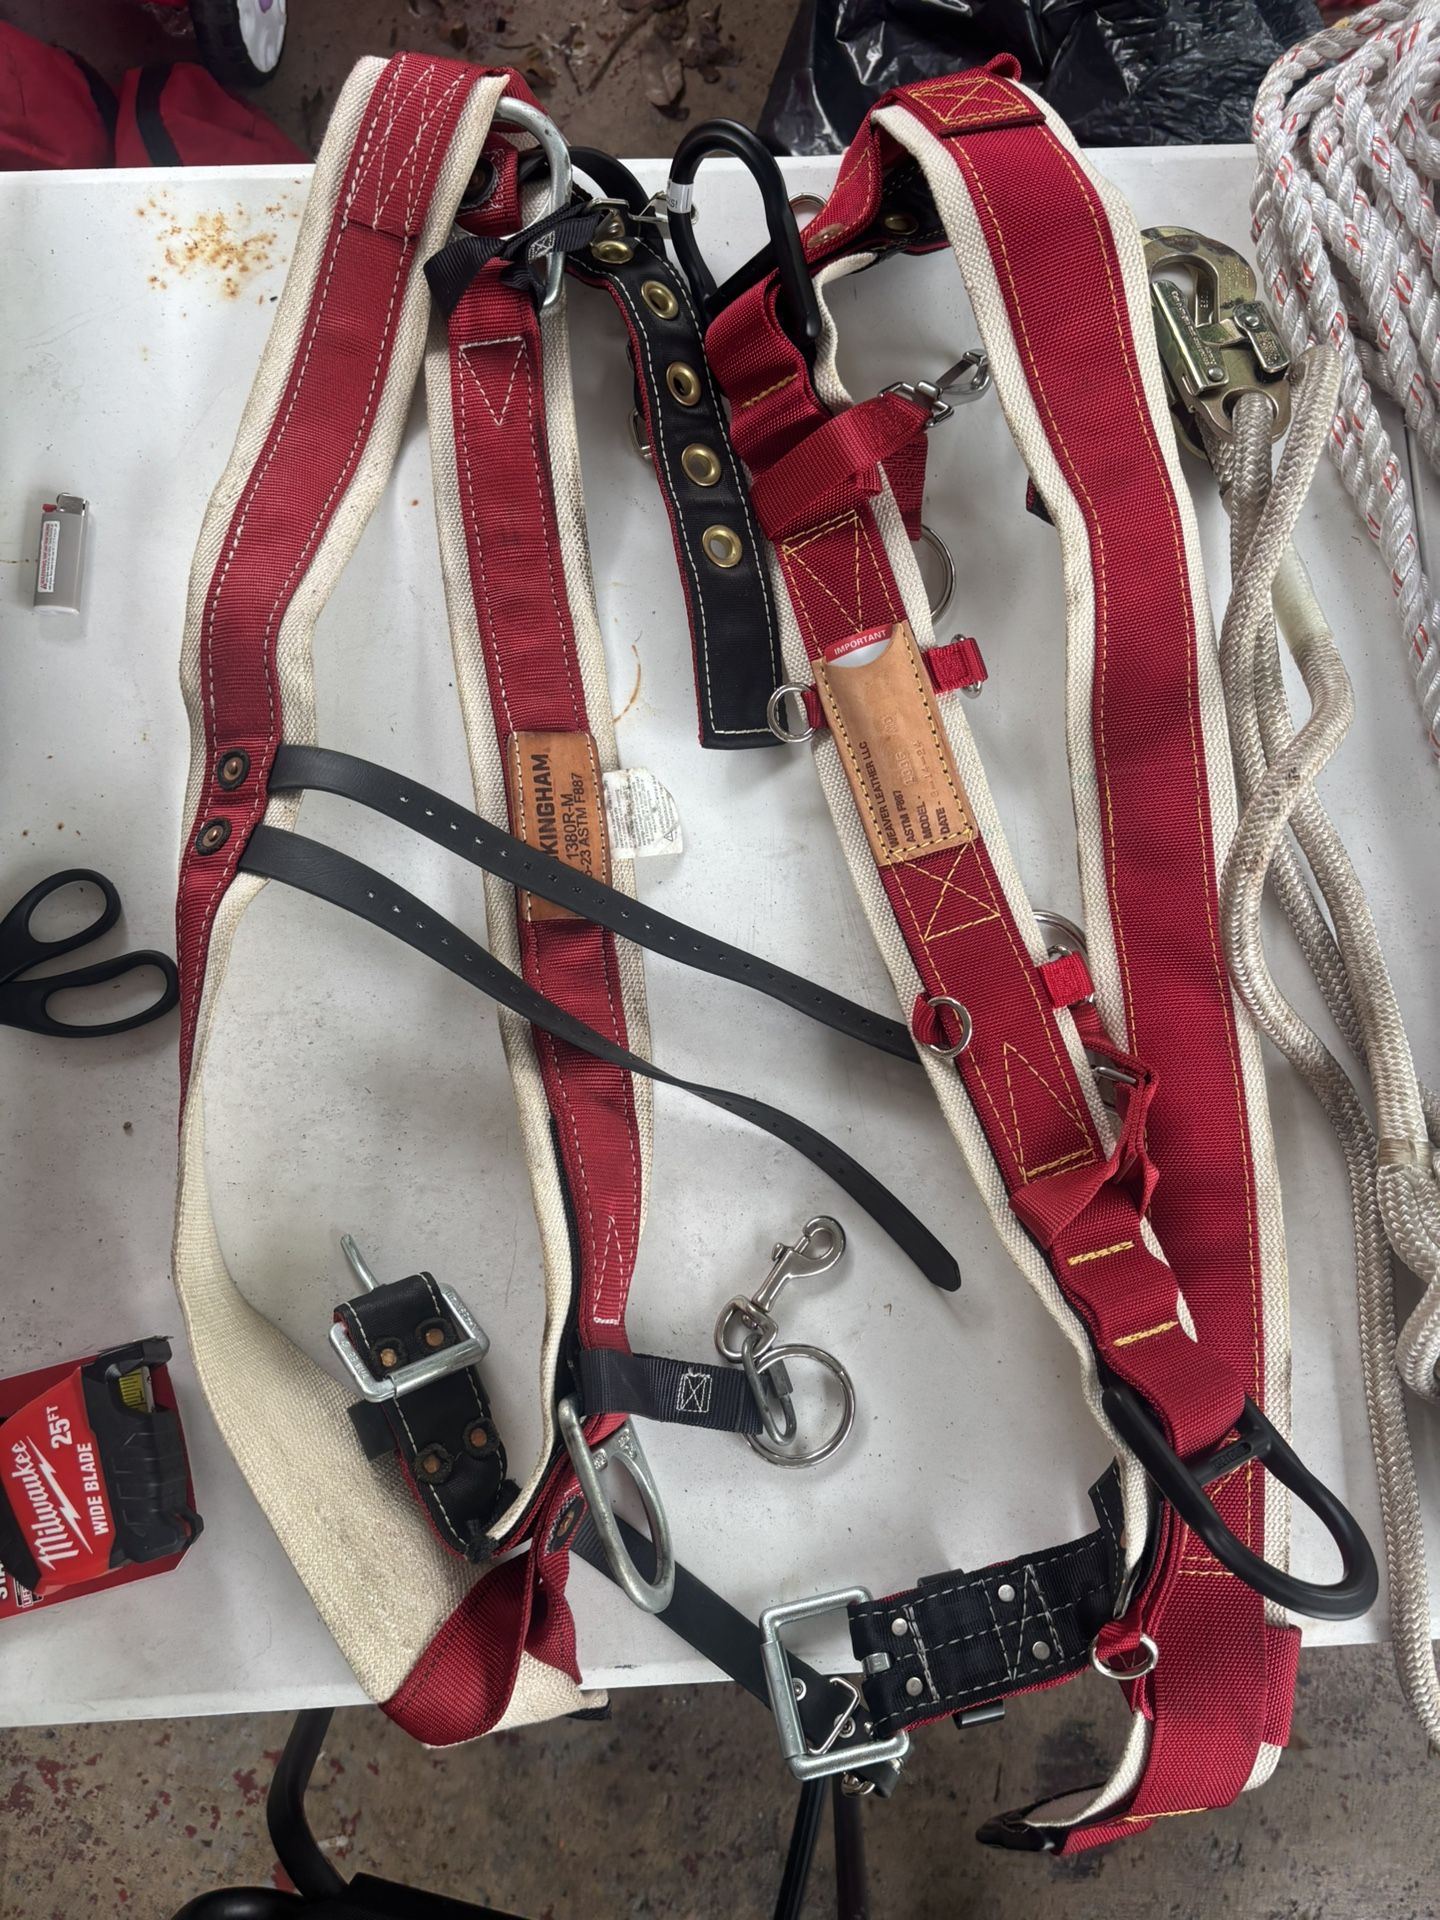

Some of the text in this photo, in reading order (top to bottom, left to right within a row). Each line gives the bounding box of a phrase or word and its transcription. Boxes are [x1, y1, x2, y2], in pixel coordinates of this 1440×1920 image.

[834, 630, 886, 655] IMPORTANT
[531, 754, 559, 860] KINGHAM
[571, 772, 586, 803] F887
[859, 741, 900, 848] WEAVER LEATHER LLC
[560, 793, 579, 860] 1380R-M
[576, 807, 591, 847] ASTM
[893, 790, 916, 843] ASTM F887
[916, 801, 933, 839] MODEL
[935, 807, 951, 835] DATE
[11, 1440, 79, 1571] Milwaukee
[77, 1442, 109, 1536] WIDE BLADE
